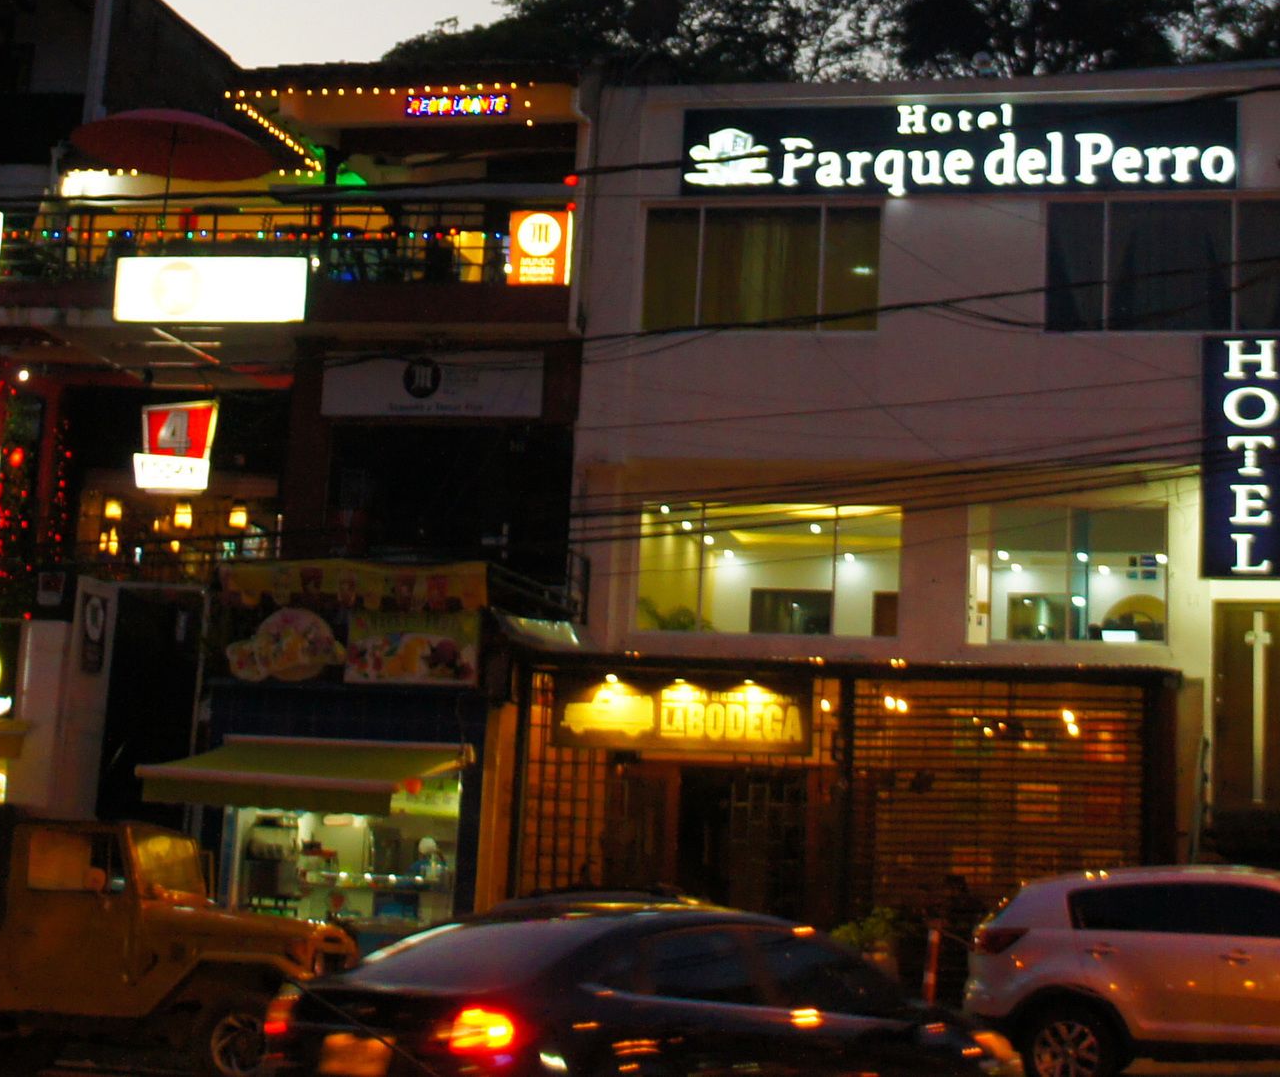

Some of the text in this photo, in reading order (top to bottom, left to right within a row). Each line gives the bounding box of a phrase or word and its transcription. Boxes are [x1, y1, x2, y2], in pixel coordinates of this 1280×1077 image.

[896, 103, 1013, 135] Hotel
[777, 131, 1236, 197] Parque del Perro
[1222, 339, 1280, 574] HOTEL
[661, 702, 802, 742] LA BODEGA
